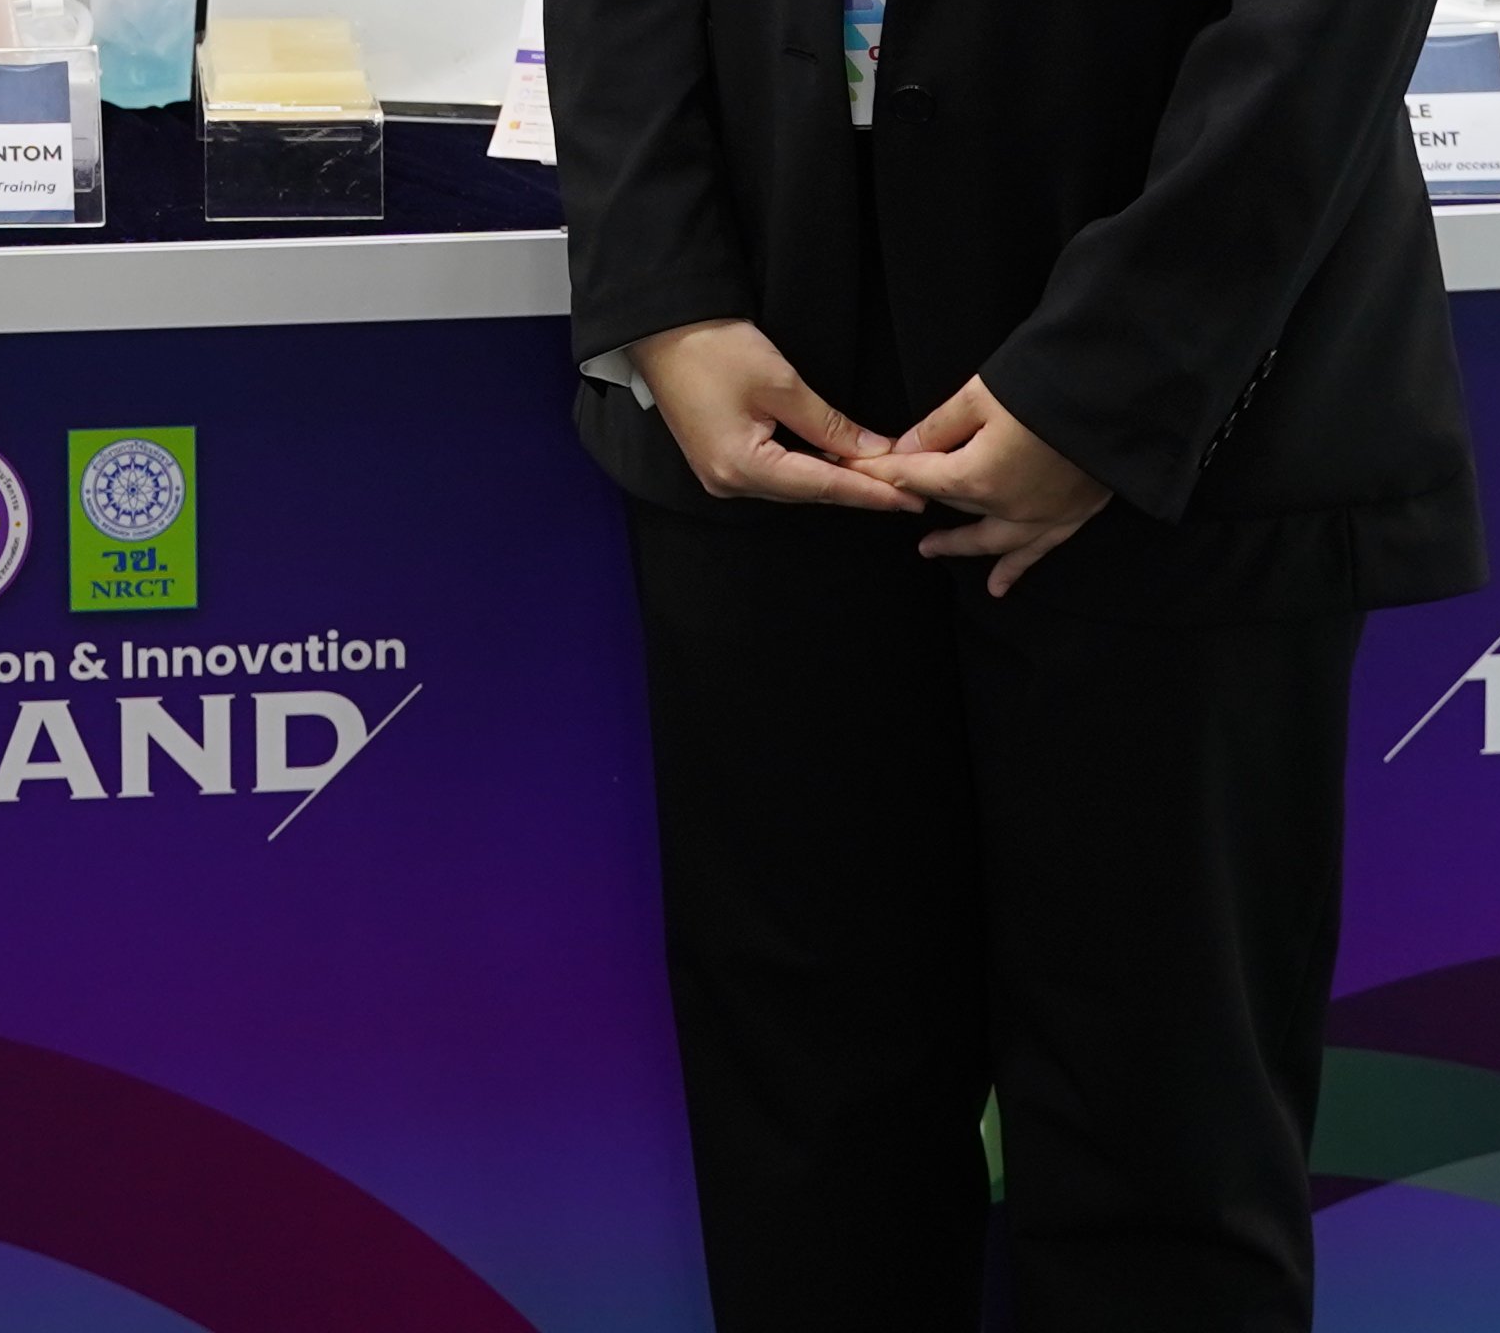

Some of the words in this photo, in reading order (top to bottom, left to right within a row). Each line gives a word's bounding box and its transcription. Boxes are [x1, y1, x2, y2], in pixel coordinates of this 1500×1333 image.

[101, 546, 169, 574] วช.
[90, 578, 176, 599] NRCT
[68, 645, 108, 682] &
[121, 632, 406, 682] Innovation
